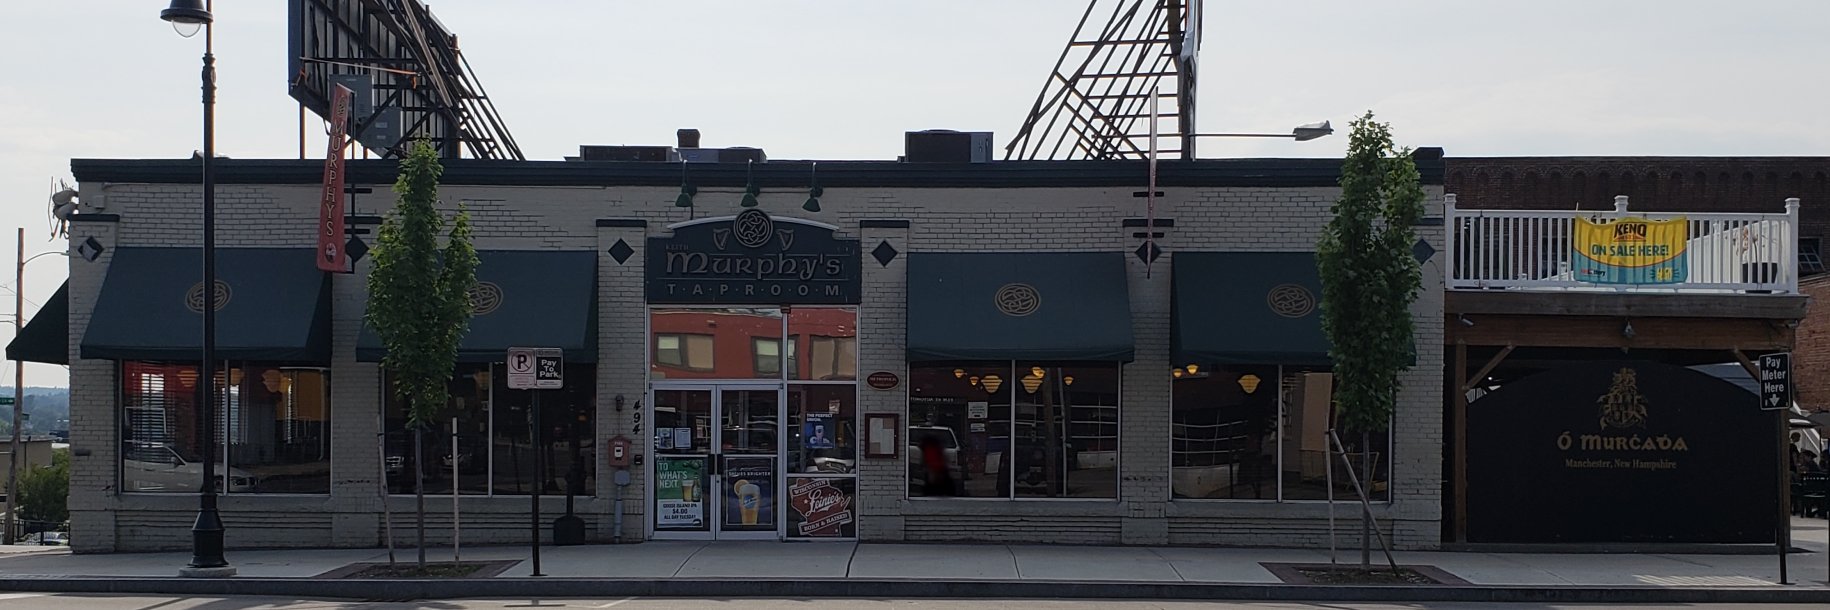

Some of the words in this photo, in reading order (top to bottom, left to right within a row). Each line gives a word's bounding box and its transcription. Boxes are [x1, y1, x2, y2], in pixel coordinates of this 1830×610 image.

[325, 121, 344, 236] MURPHYS
[1613, 223, 1647, 239] KENO
[1591, 243, 1607, 256] ON
[1609, 244, 1636, 257] SALE
[1637, 243, 1669, 257] HERE!
[541, 359, 557, 367] Pay
[1765, 356, 1782, 369] Pay
[1761, 369, 1787, 381] Meter
[1764, 381, 1785, 394] Here
[658, 462, 669, 471] TO
[1565, 457, 1613, 470] Manchester,
[1614, 457, 1632, 469] New
[1632, 457, 1677, 471] Hampshire
[658, 470, 688, 480] WHAT'S
